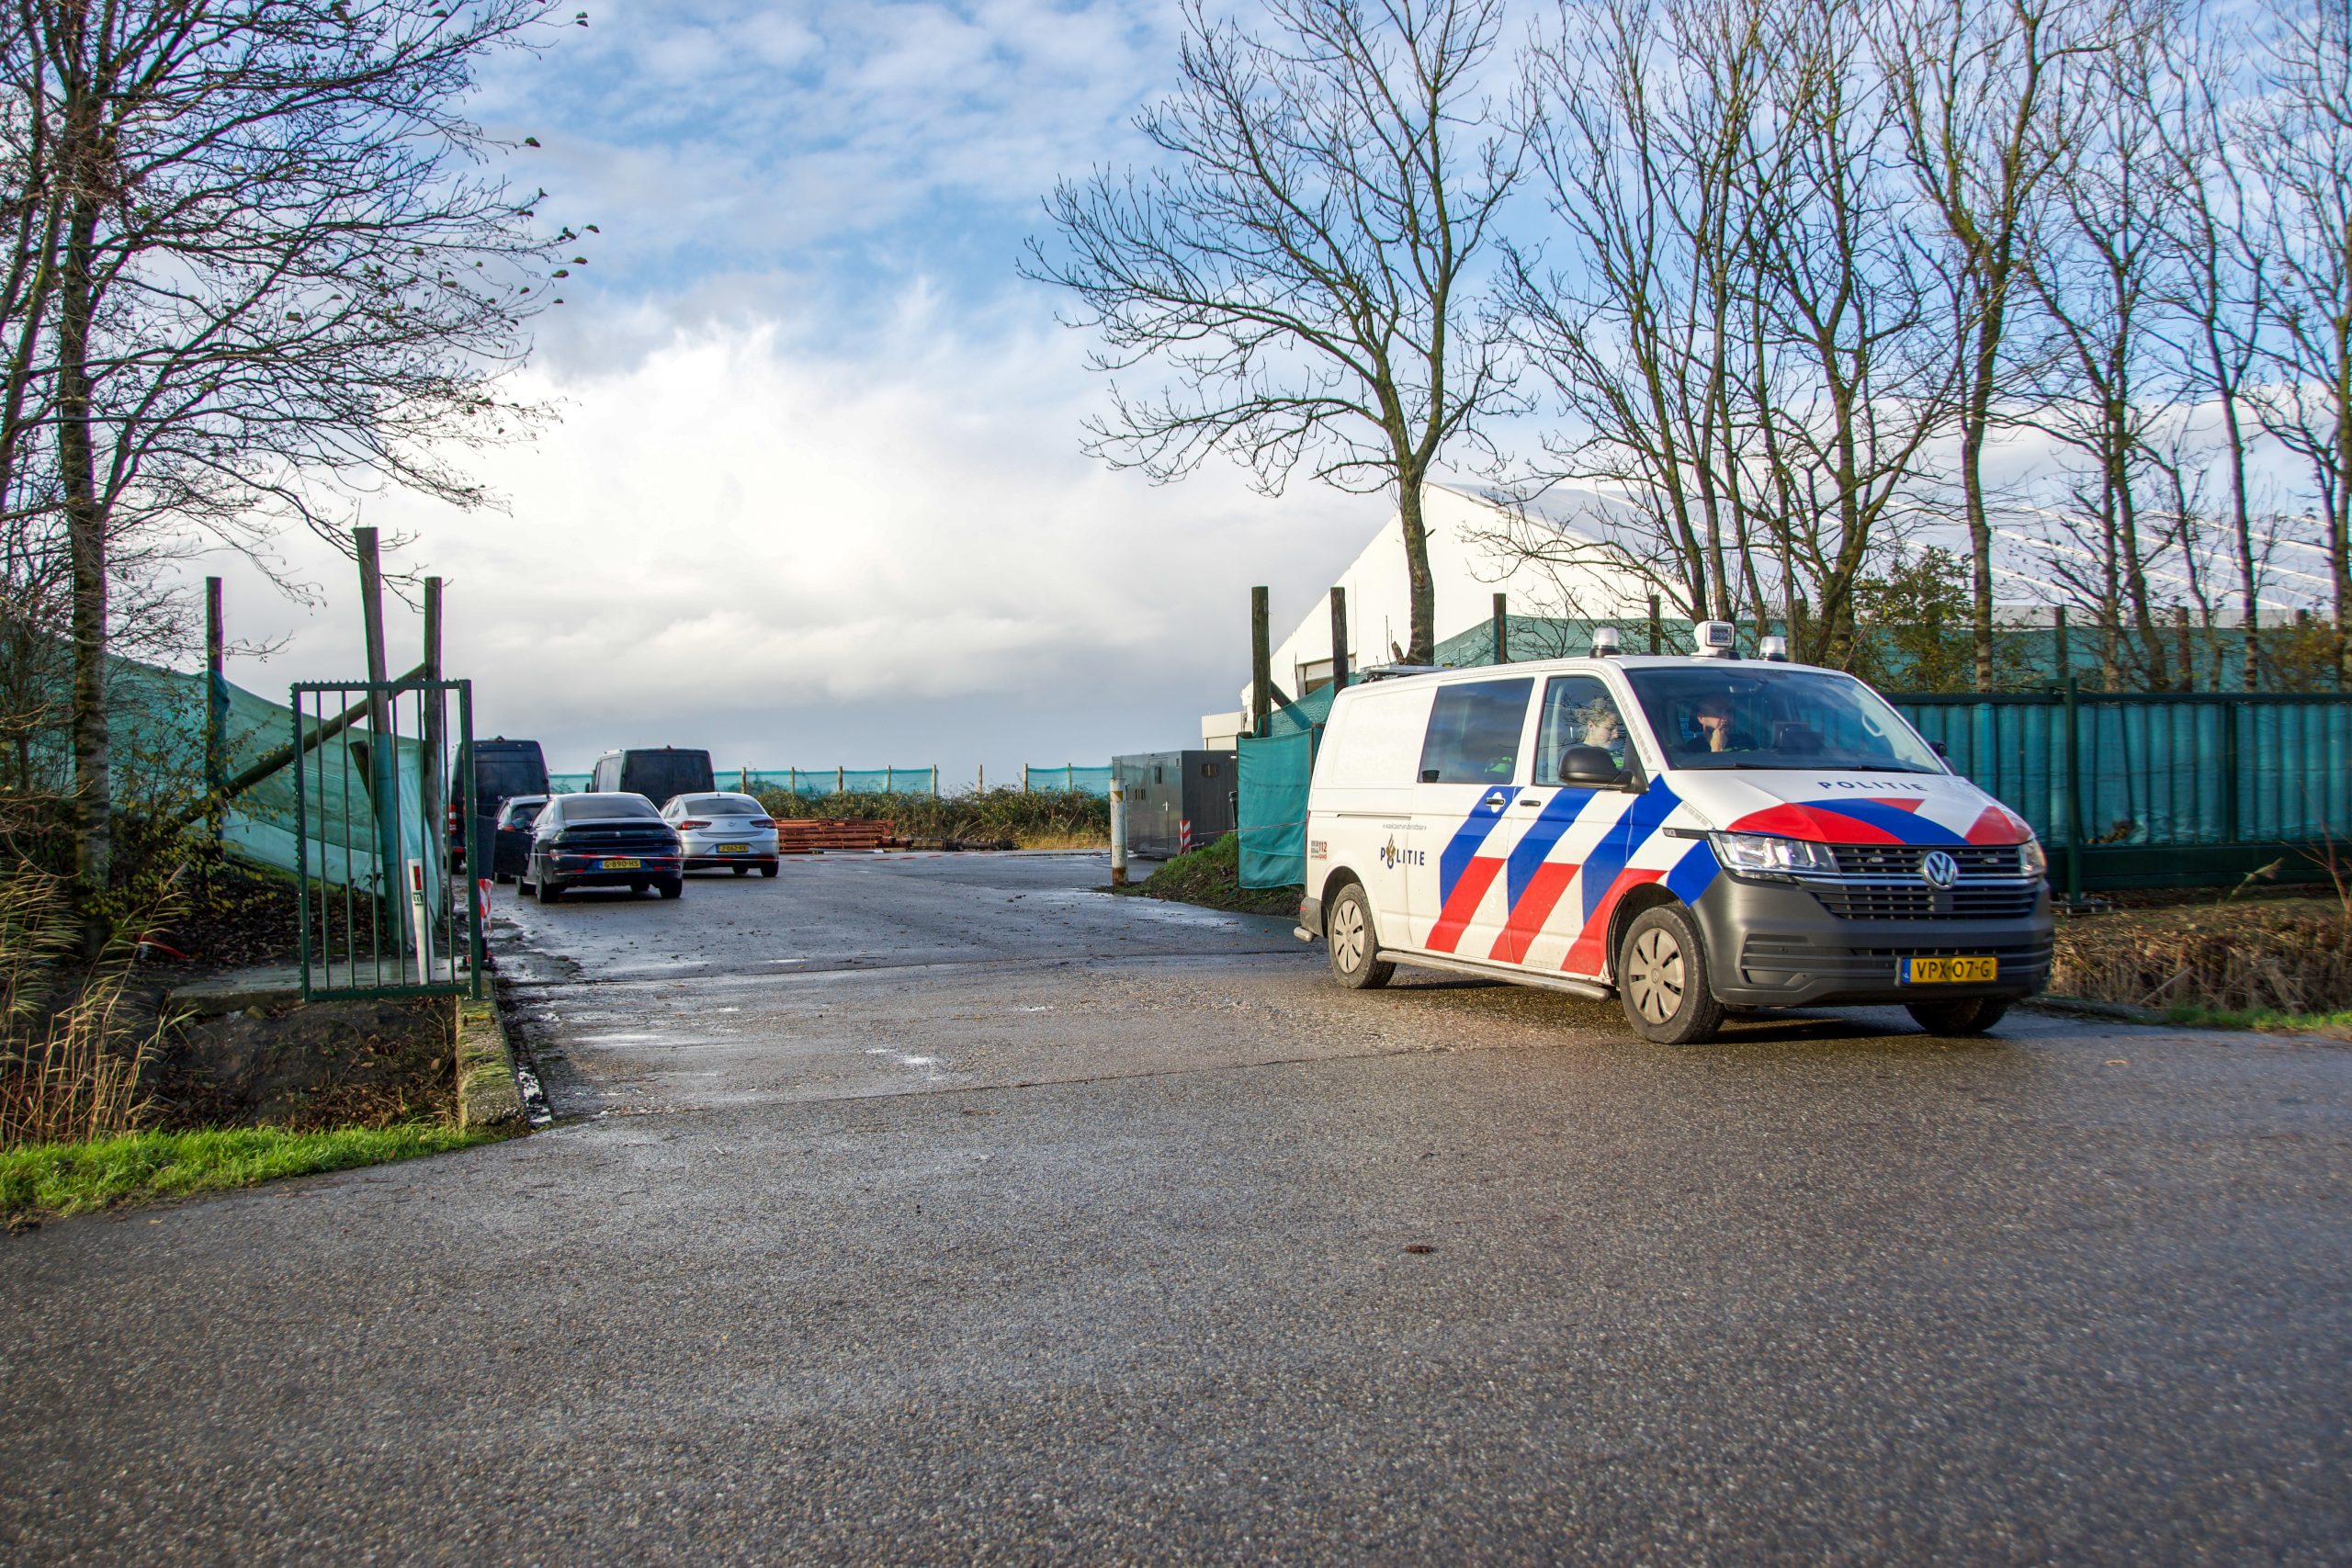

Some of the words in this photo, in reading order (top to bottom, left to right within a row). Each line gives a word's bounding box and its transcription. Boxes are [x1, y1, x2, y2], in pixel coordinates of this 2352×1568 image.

[1817, 781, 1928, 791] POLITIE
[1318, 840, 1327, 852] 112
[1380, 846, 1425, 869] POLITIE
[1916, 960, 1990, 978] VPX-07-G
